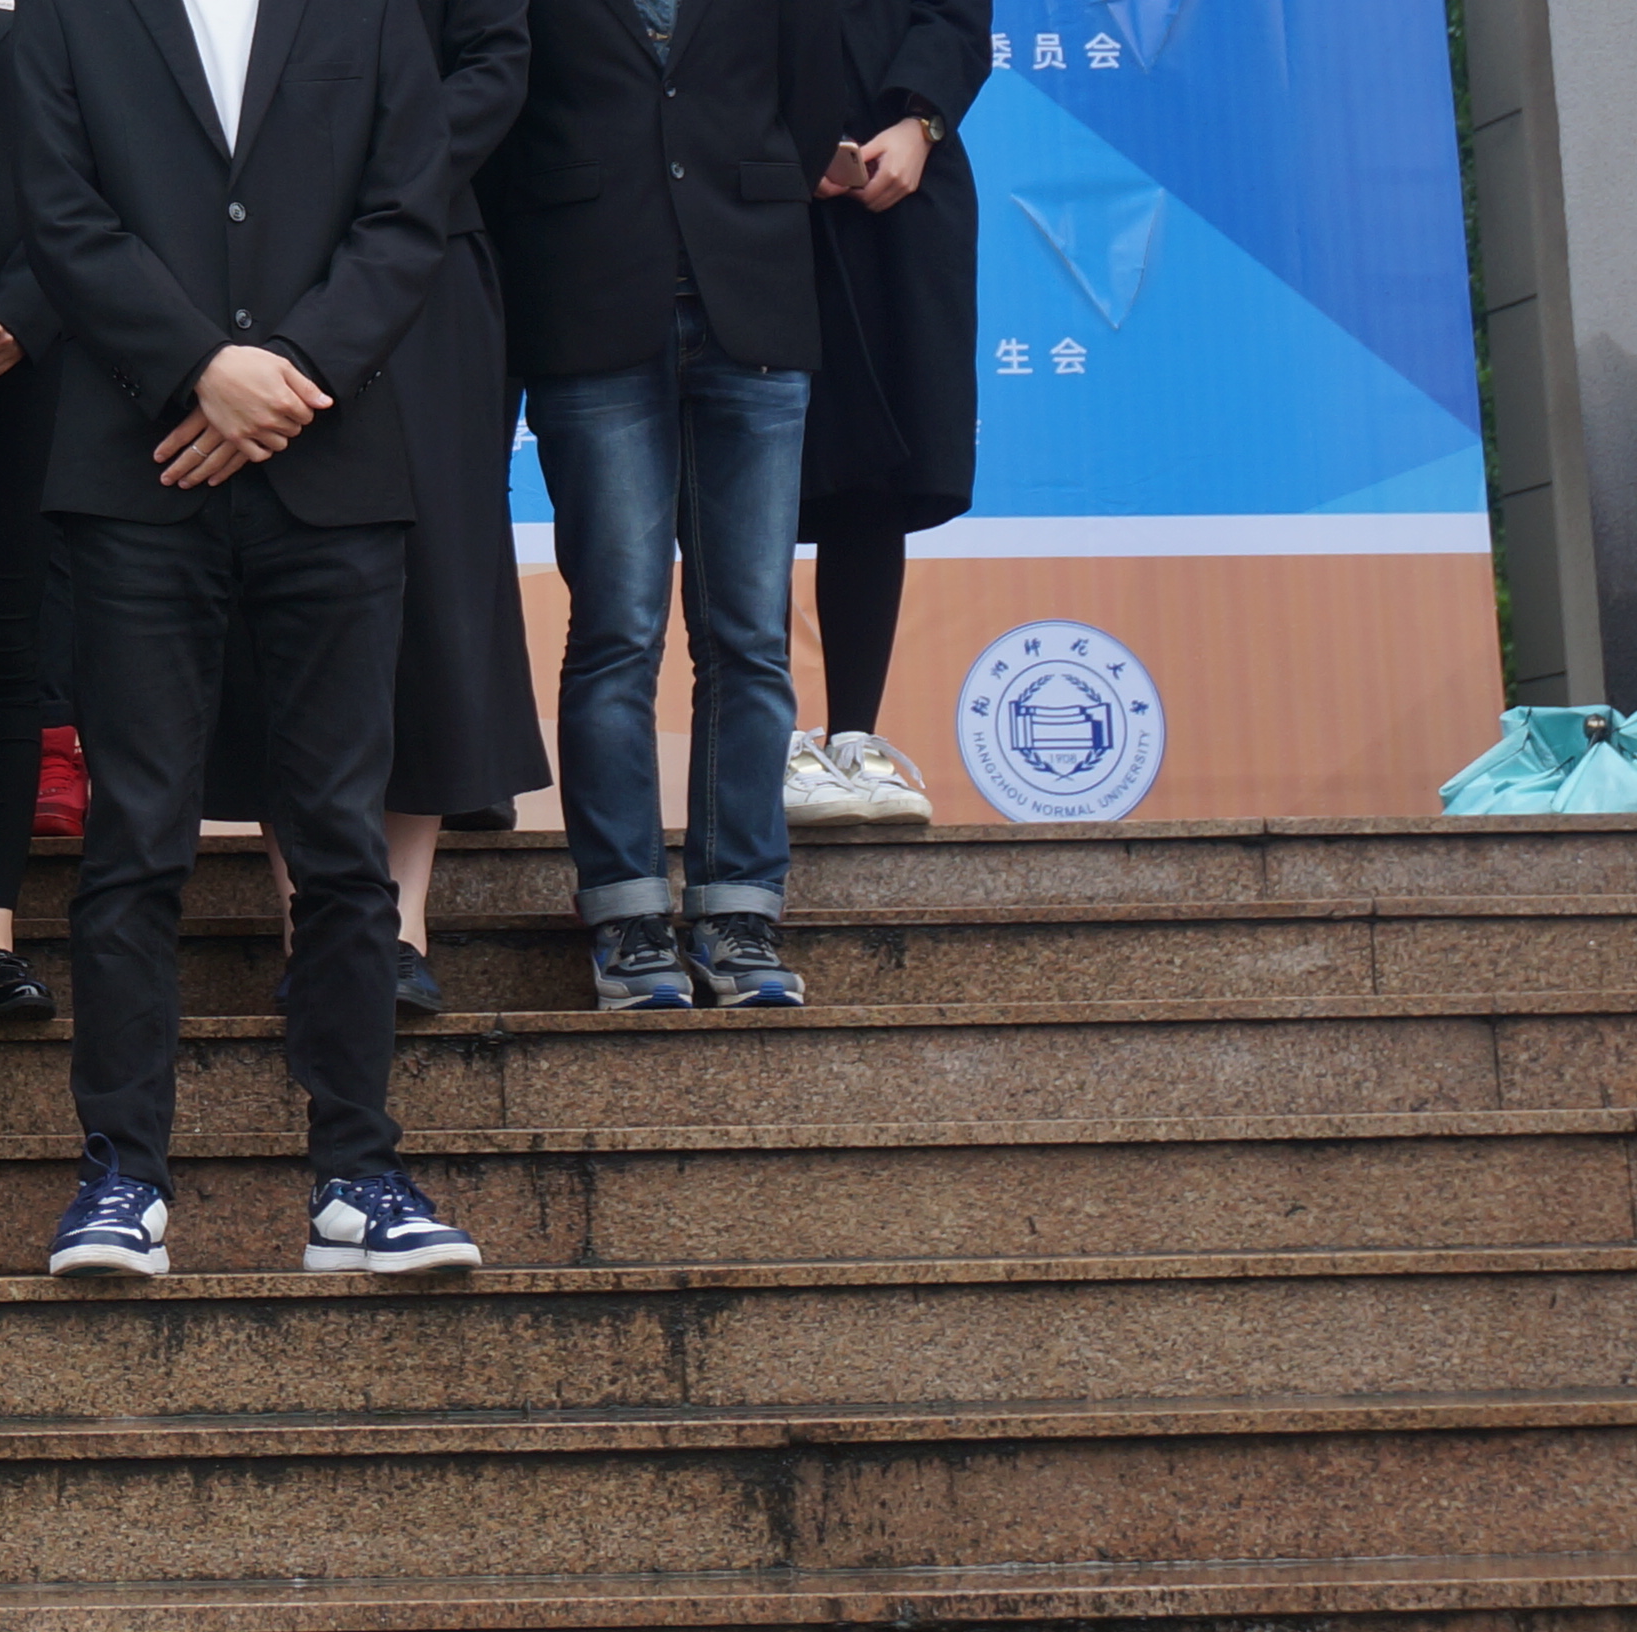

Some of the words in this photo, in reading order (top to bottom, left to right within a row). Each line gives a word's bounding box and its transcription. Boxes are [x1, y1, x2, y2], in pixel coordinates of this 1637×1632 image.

[995, 337, 1087, 374] 生会
[973, 731, 1028, 806] HANGZHOU
[1031, 800, 1095, 817] NORMAL
[1099, 729, 1151, 808] UNIVERSITY
